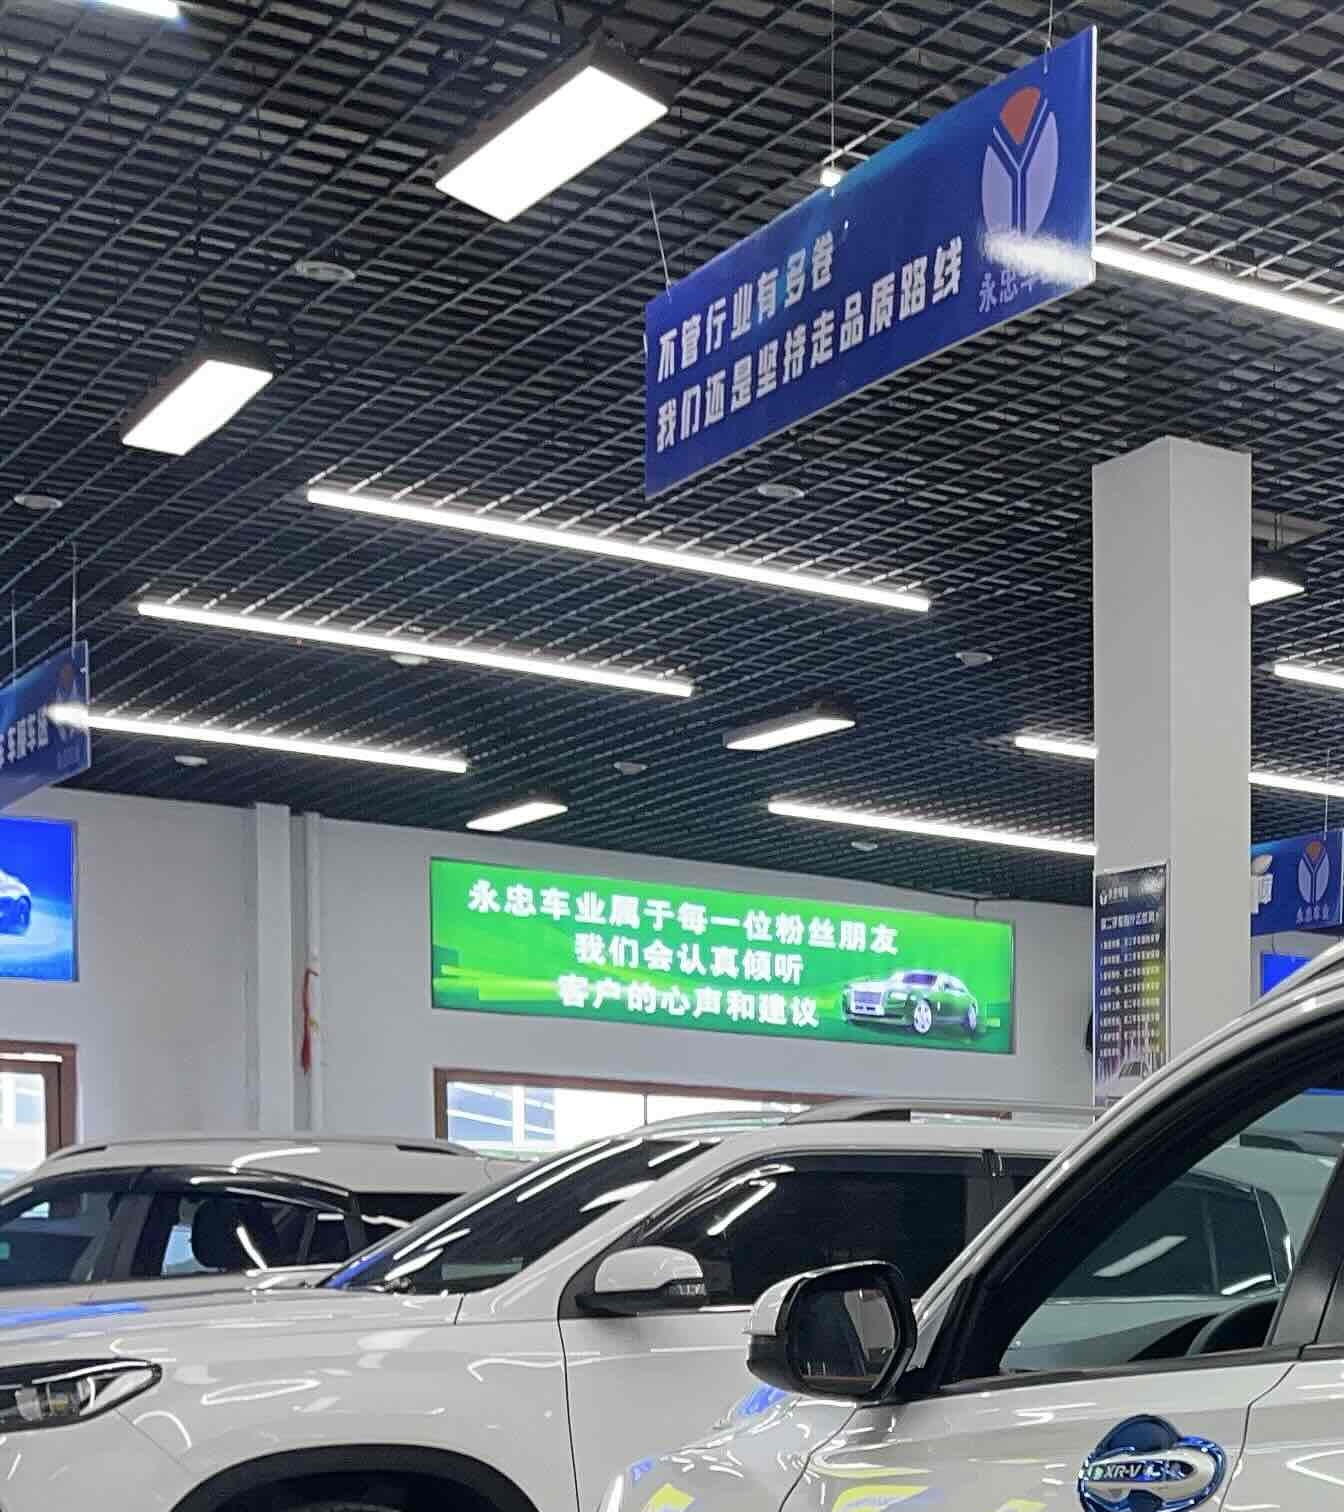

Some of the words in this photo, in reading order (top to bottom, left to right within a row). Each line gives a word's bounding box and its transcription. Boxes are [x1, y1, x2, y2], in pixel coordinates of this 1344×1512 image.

[657, 231, 833, 383] 不管行业有多卷
[656, 236, 963, 454] 我们还是坚持走品质路线
[467, 879, 898, 955] 永忠车业属于每一位粉丝朋友
[574, 932, 804, 984] 我们会认真倾听
[556, 973, 820, 1028] 客户的心声和建议
[1104, 1464, 1142, 1478] XR-V
